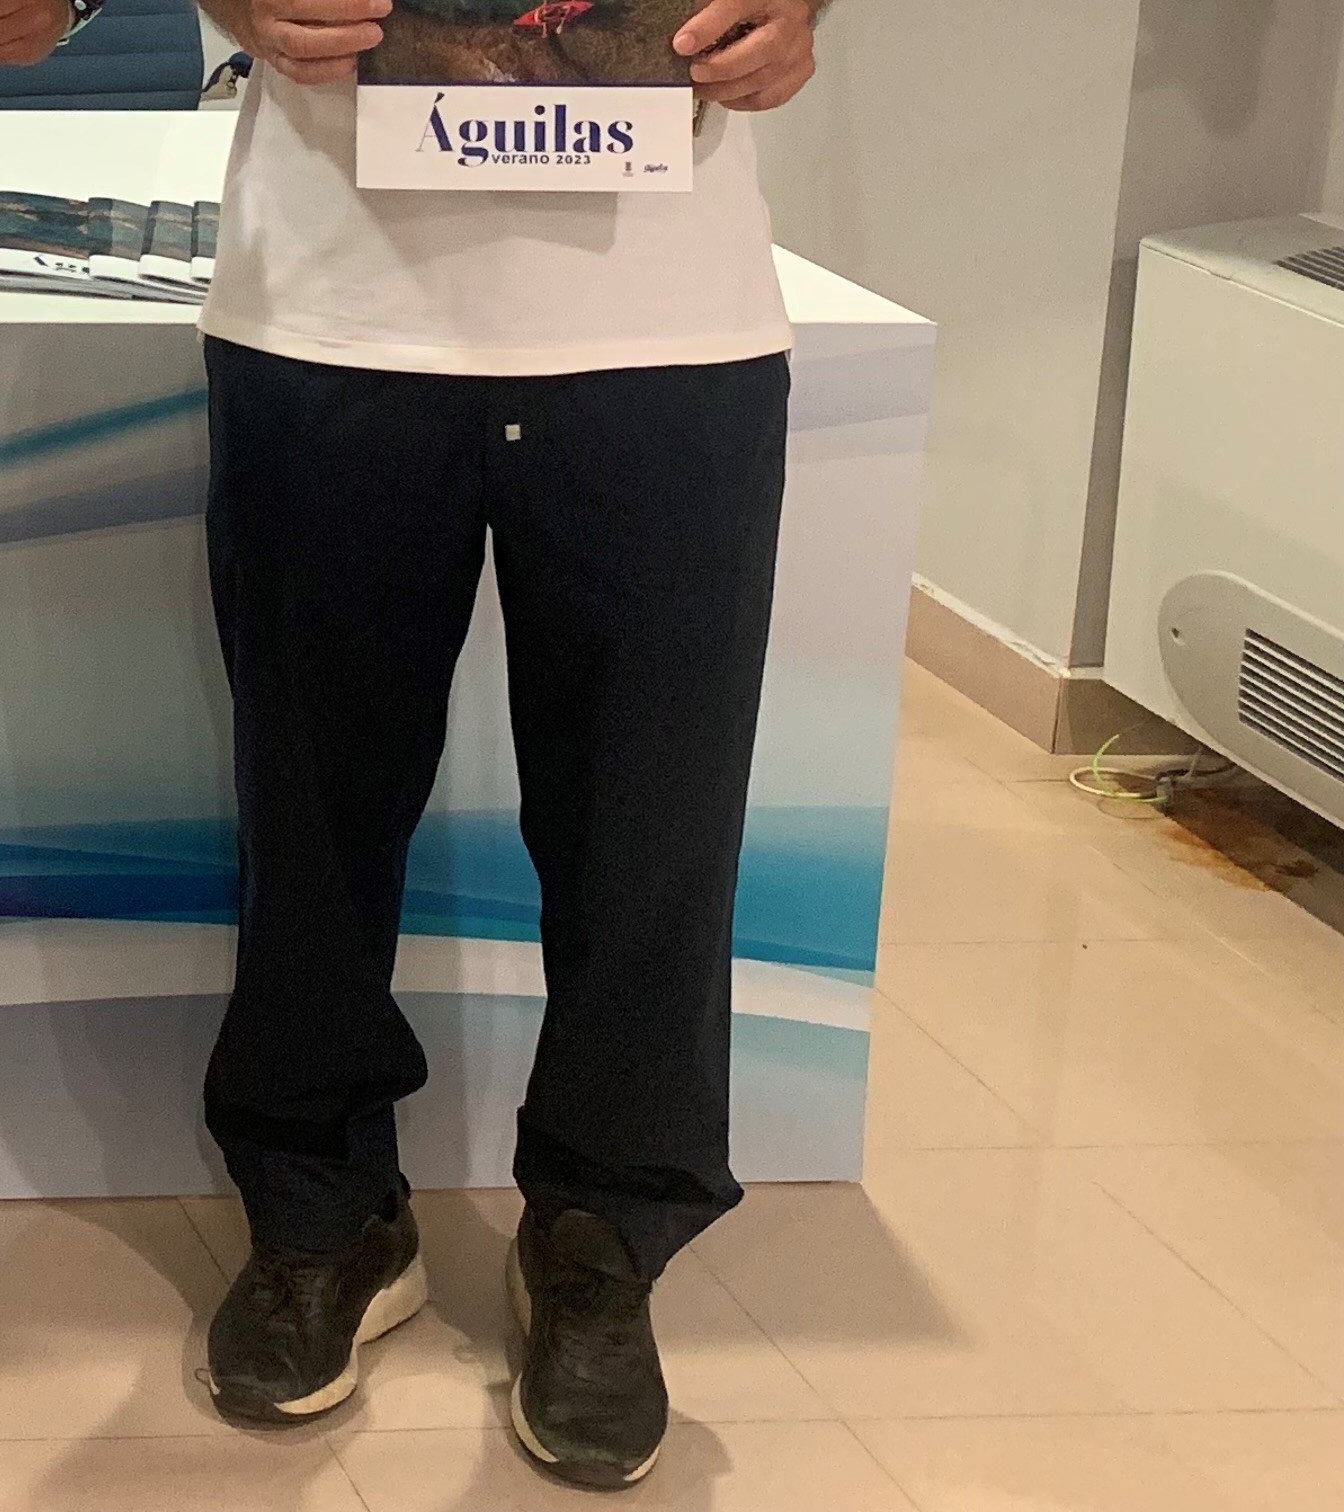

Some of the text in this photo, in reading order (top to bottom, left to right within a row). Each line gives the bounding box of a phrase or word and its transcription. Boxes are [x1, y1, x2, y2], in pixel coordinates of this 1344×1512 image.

[416, 91, 634, 168] Águilas
[491, 153, 592, 165] verano 2023
